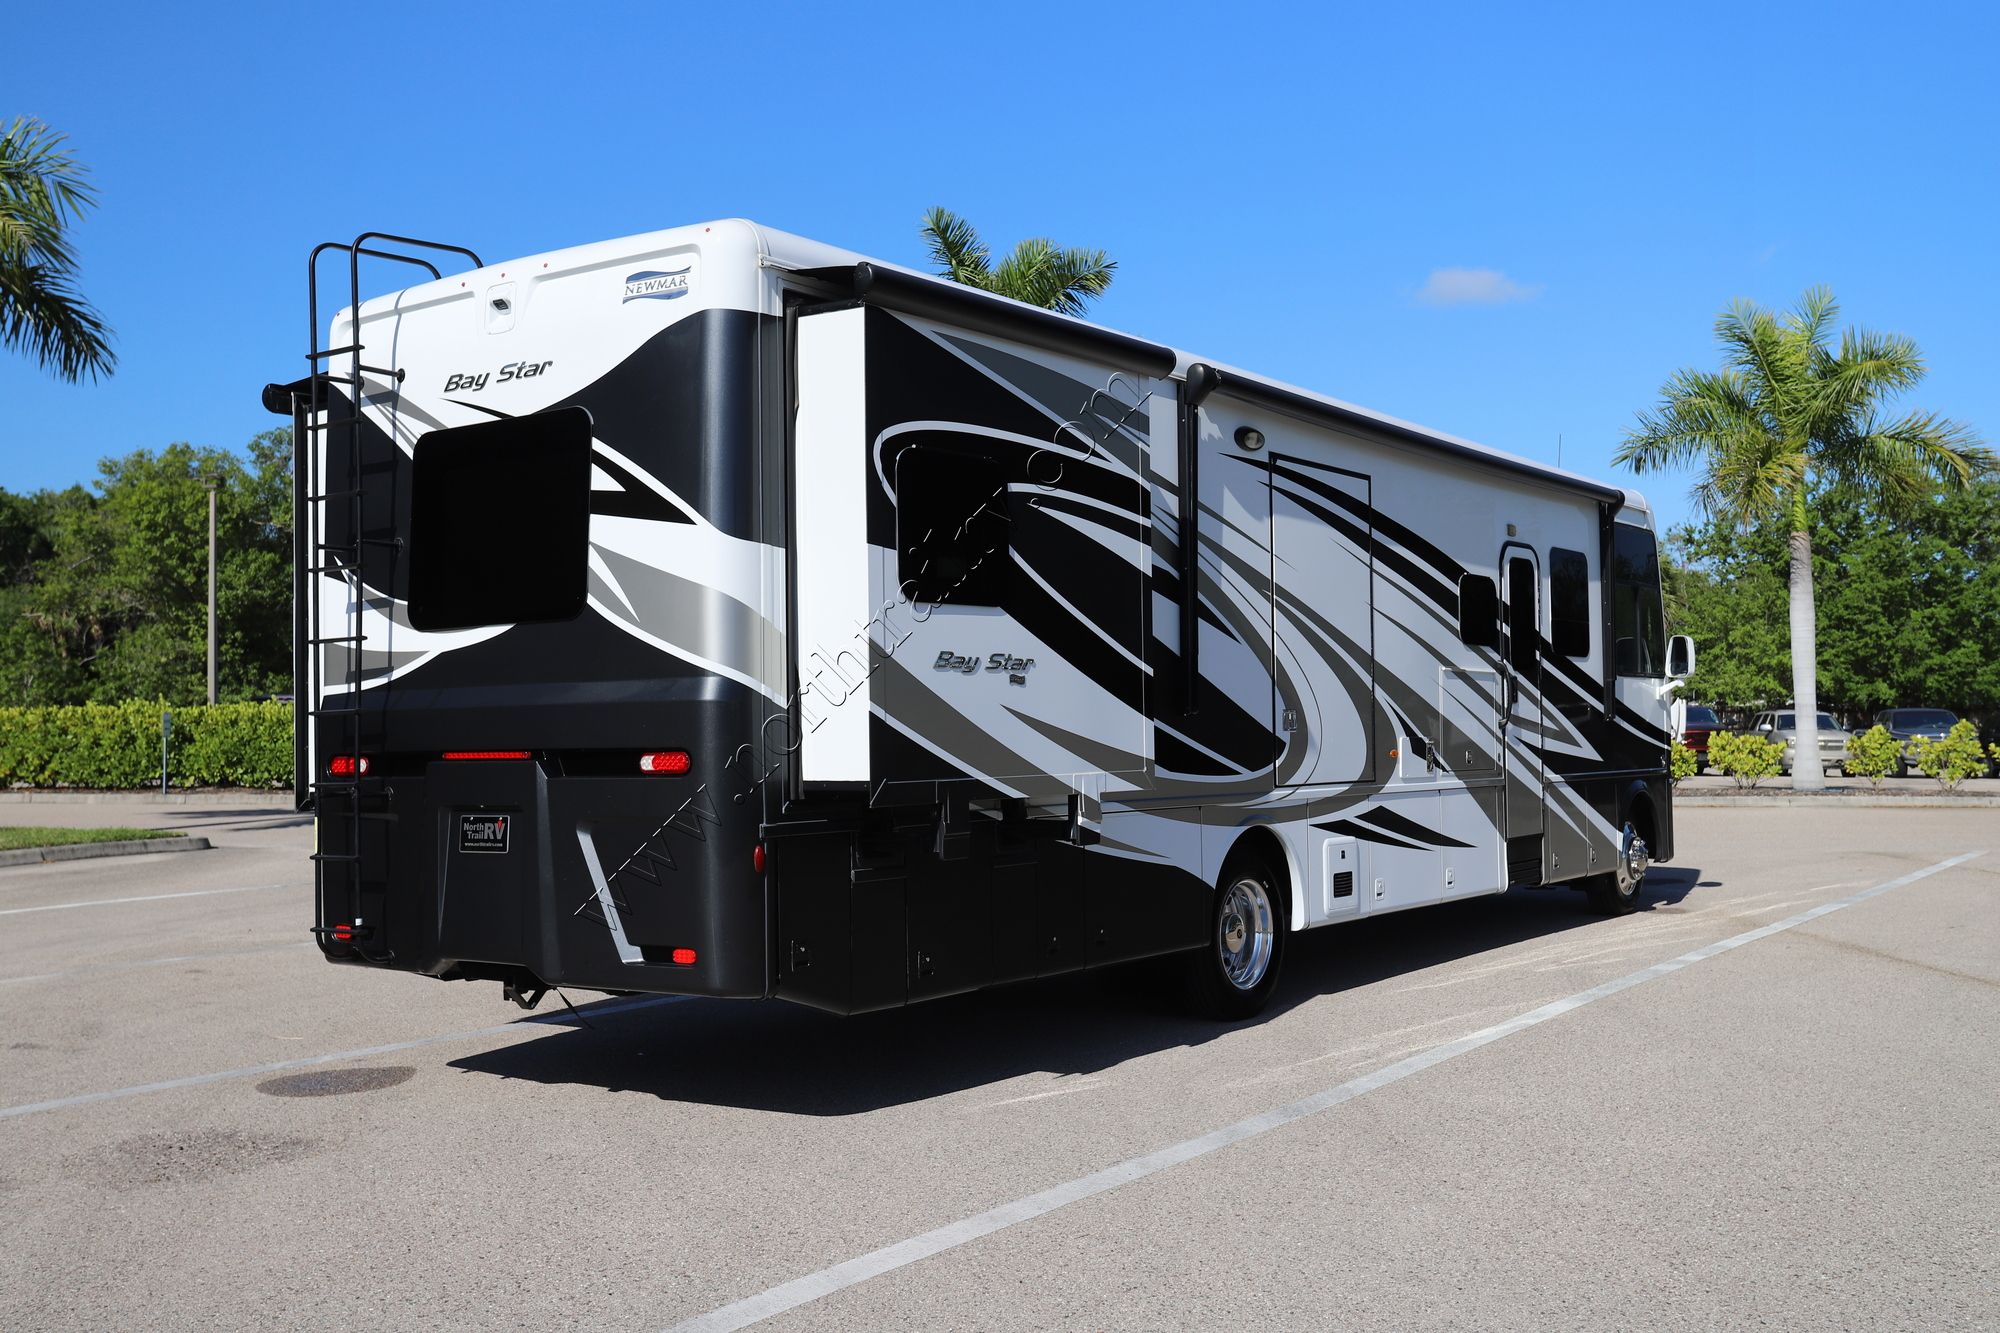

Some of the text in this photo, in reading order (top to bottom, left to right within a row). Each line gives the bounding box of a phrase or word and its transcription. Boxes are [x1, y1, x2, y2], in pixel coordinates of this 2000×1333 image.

[625, 275, 688, 296] NEWMAR
[444, 361, 553, 393] Bay Star
[933, 651, 1035, 674] Bay Star
[463, 822, 484, 831] North
[466, 831, 484, 840] Trail
[484, 822, 506, 840] RV
